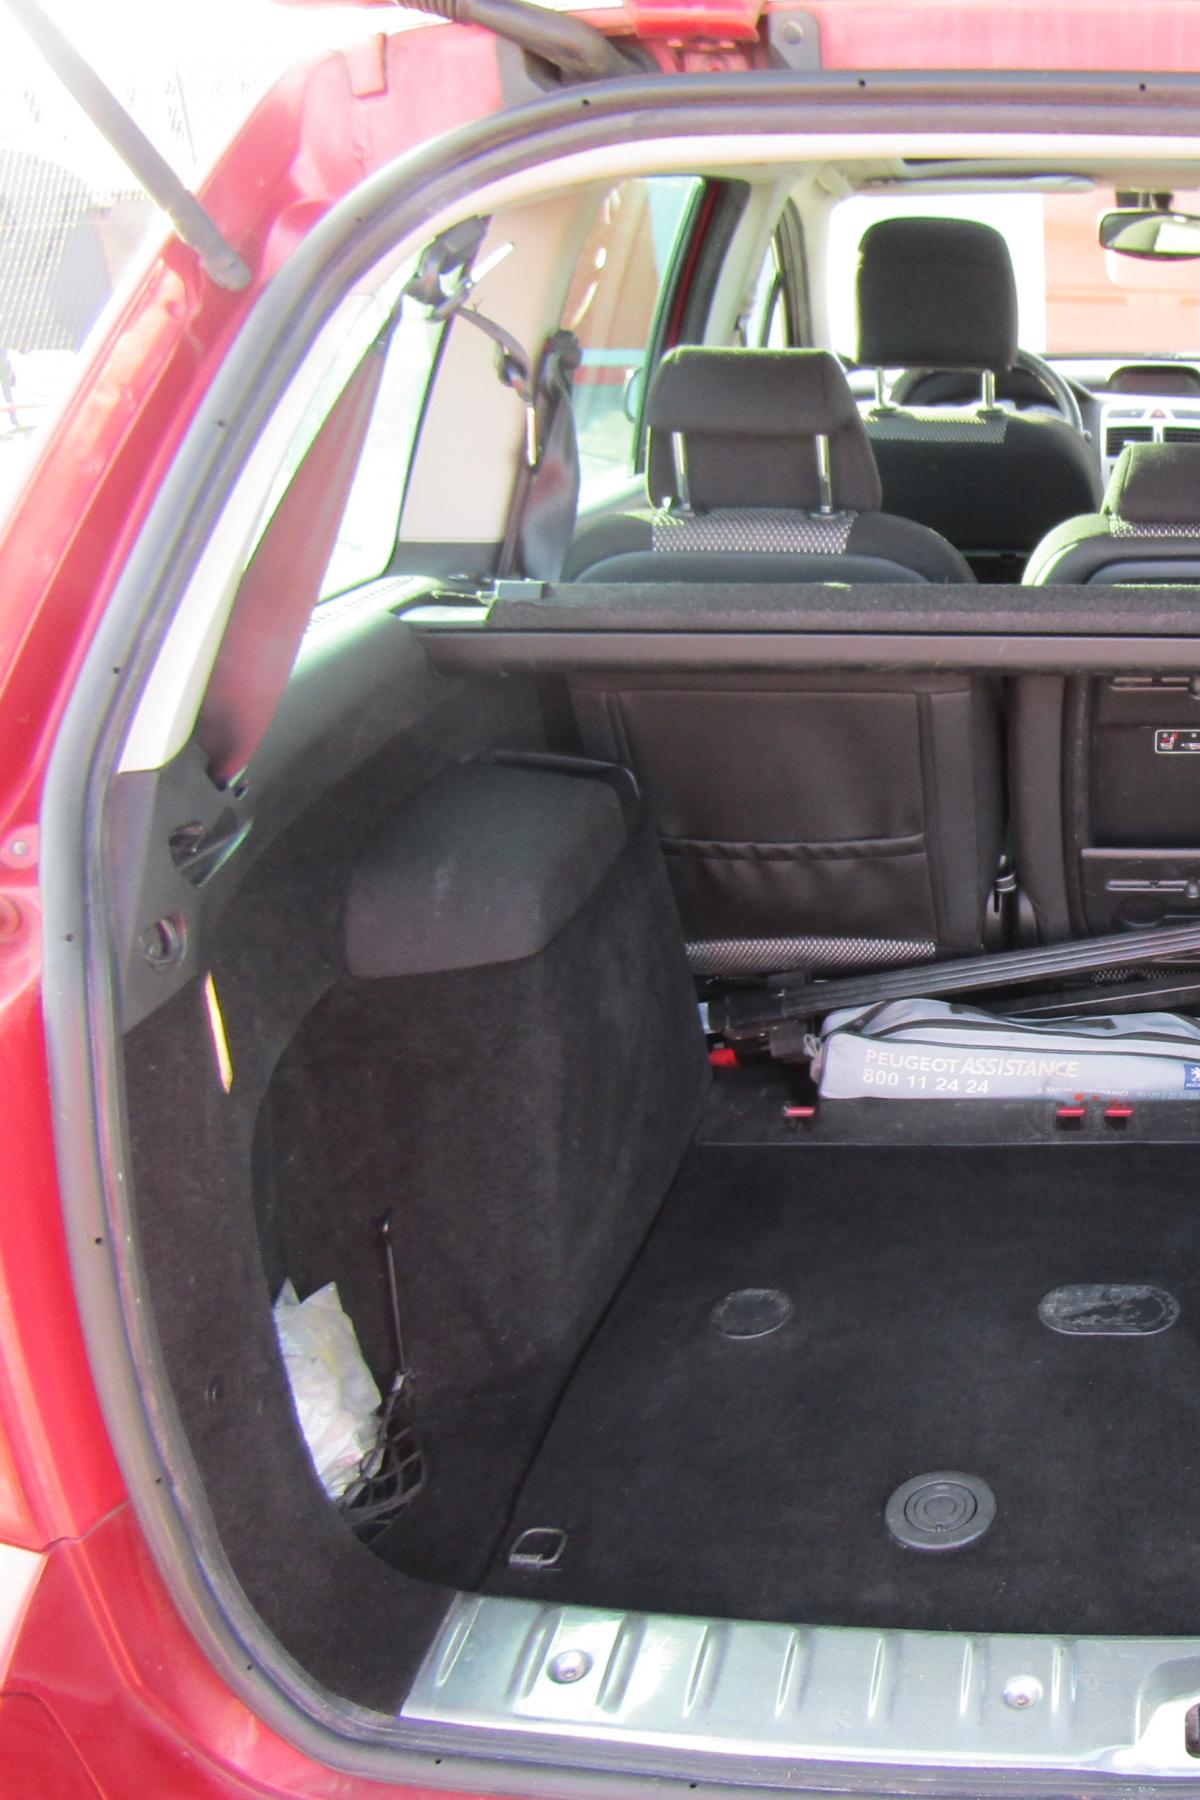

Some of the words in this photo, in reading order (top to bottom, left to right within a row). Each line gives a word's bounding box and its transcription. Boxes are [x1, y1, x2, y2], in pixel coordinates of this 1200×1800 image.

[865, 1049, 960, 1075] PEUGEOT
[959, 1056, 1080, 1079] ASSISTANCE
[862, 1067, 899, 1087] 800
[906, 1075, 927, 1090] 11
[935, 1076, 959, 1093] 24
[964, 1079, 990, 1095] 24
